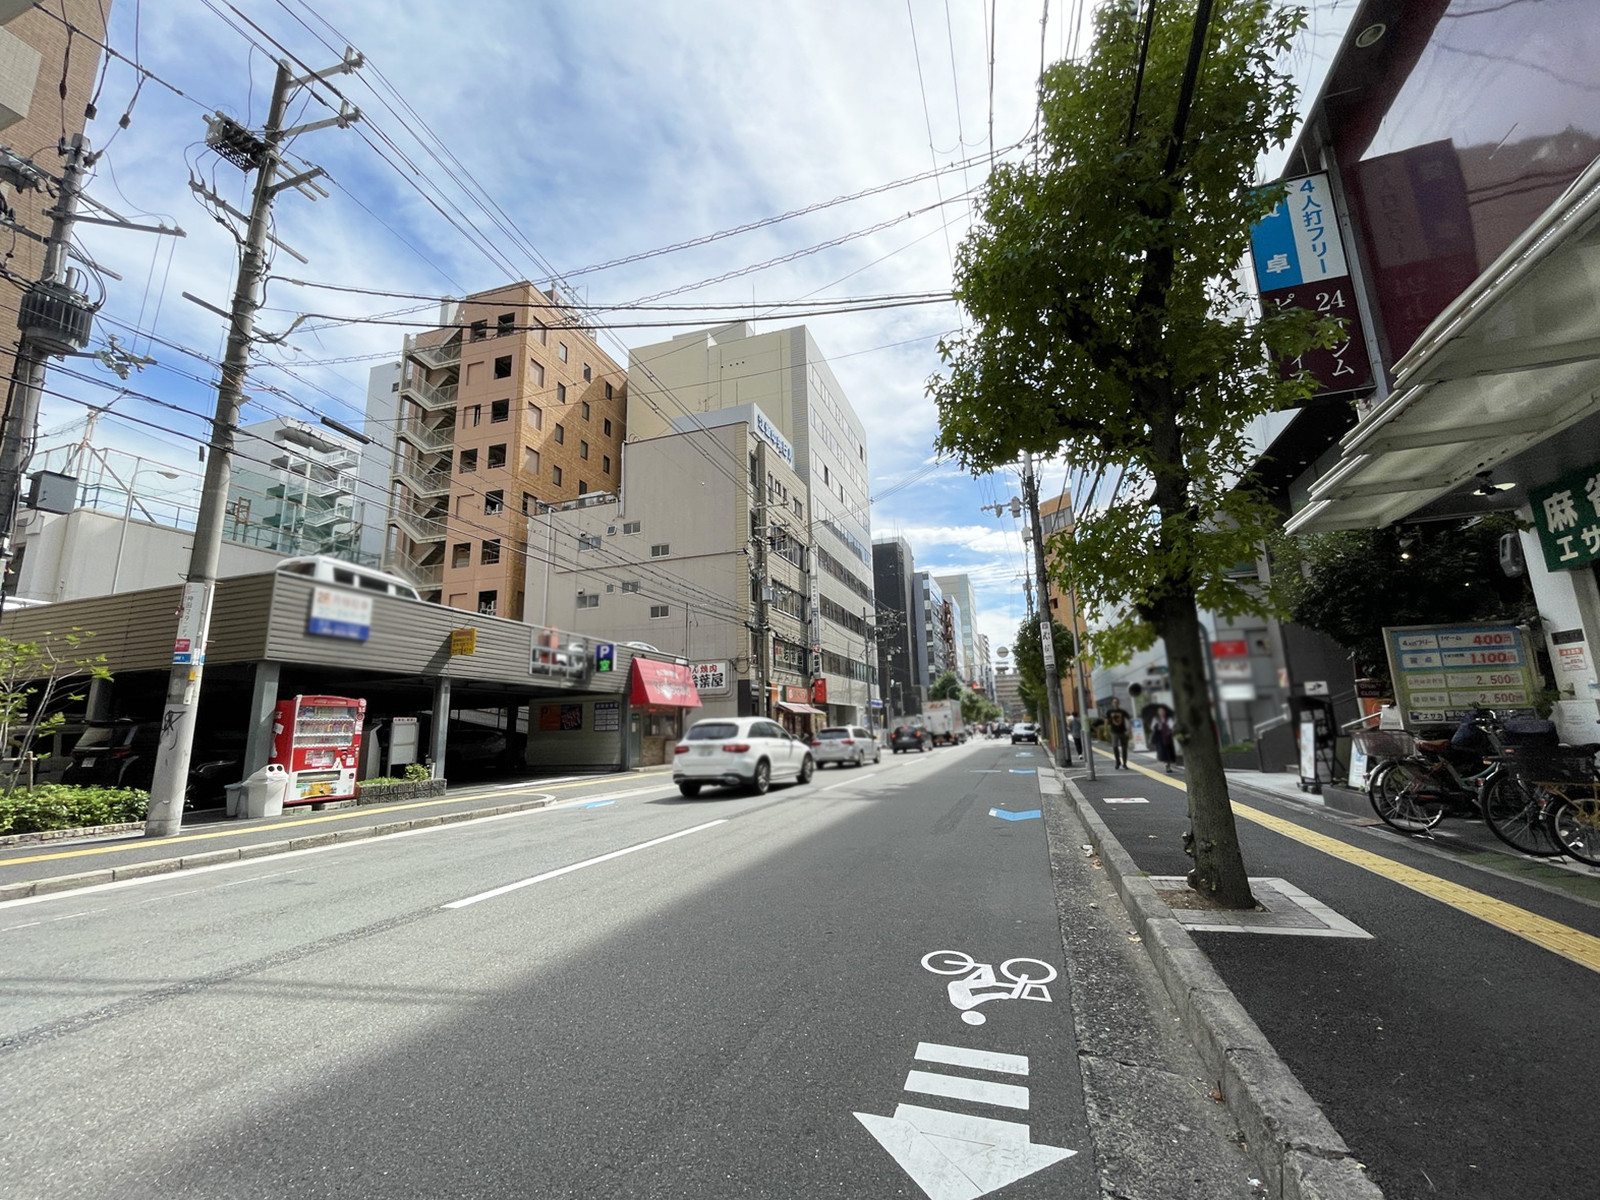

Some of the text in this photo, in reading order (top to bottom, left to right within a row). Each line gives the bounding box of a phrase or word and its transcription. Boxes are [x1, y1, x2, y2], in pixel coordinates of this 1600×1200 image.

[1300, 179, 1327, 274] 4人打フリー
[600, 646, 610, 658] P
